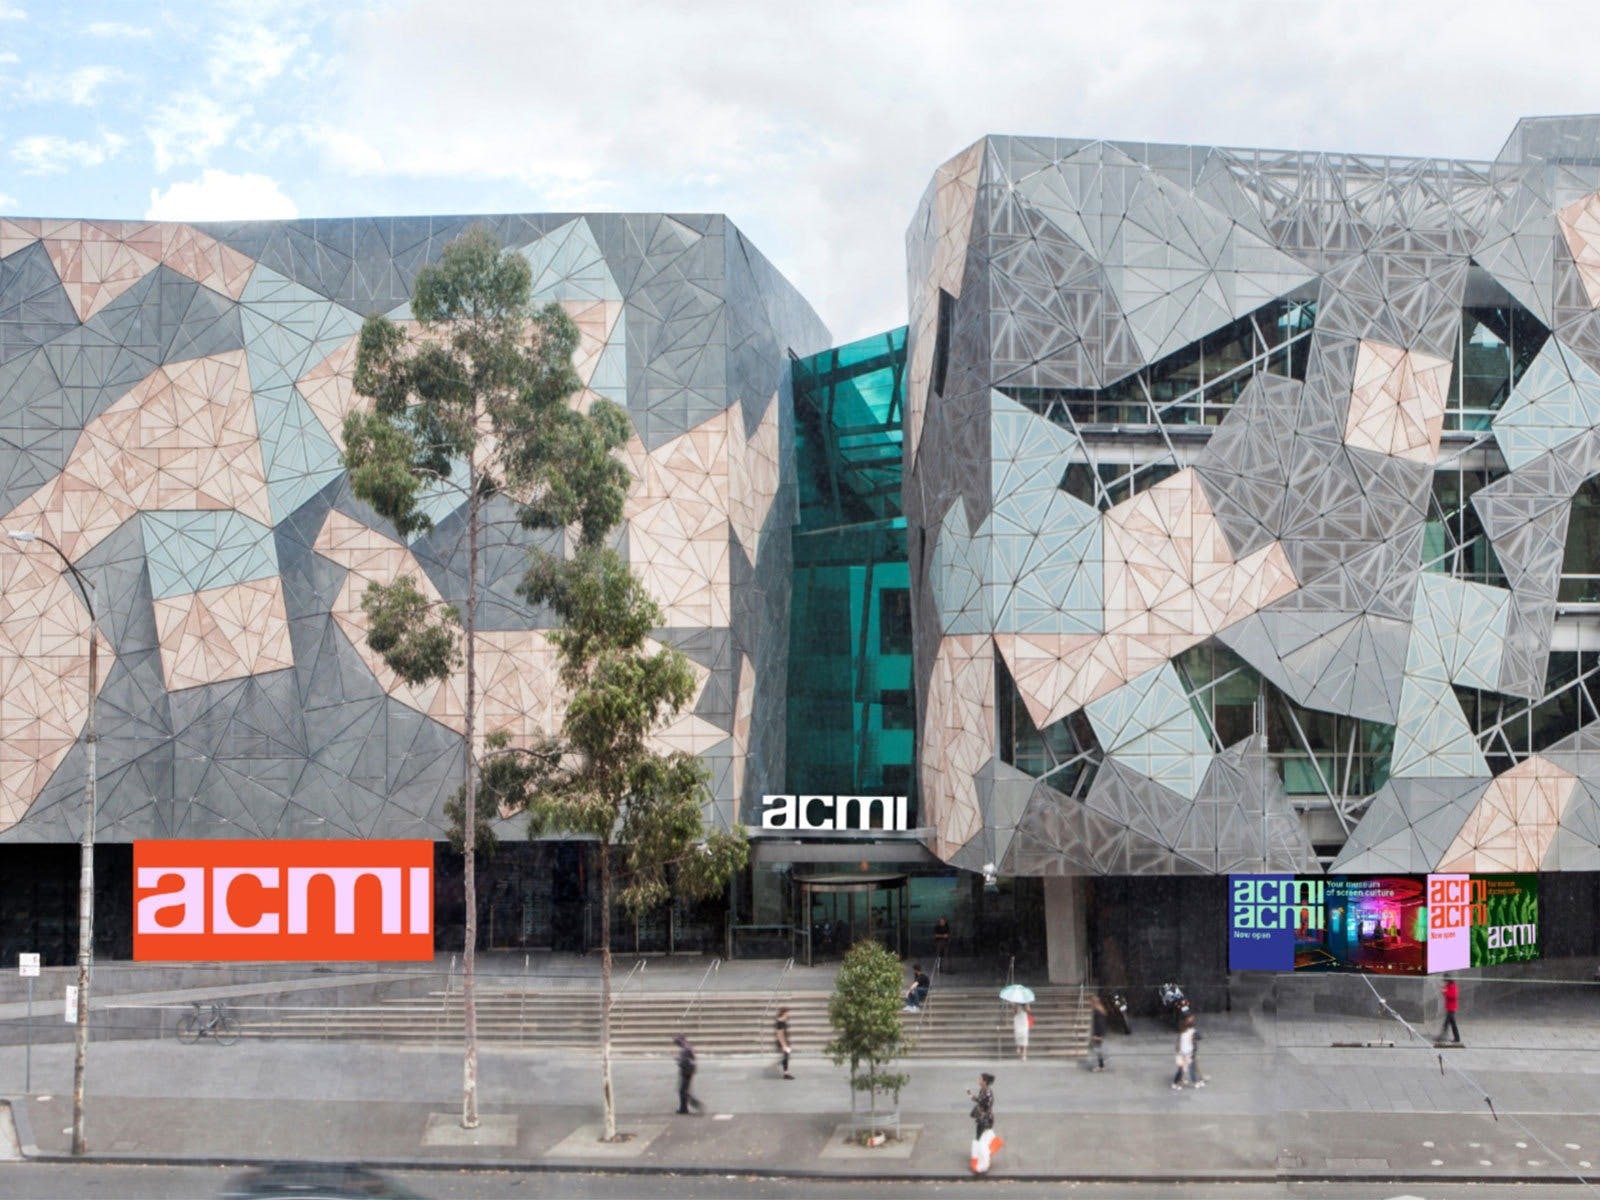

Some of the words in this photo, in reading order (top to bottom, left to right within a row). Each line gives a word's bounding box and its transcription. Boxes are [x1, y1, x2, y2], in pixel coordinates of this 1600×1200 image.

[762, 795, 907, 831] acmi
[138, 867, 430, 935] acmi
[1234, 880, 1324, 904] acmi
[1431, 880, 1486, 903] acmi
[1234, 905, 1324, 929] acmi
[1431, 905, 1487, 929] acmi
[1234, 931, 1250, 939] Now
[1252, 932, 1271, 940] open
[1488, 923, 1536, 950] acmi
